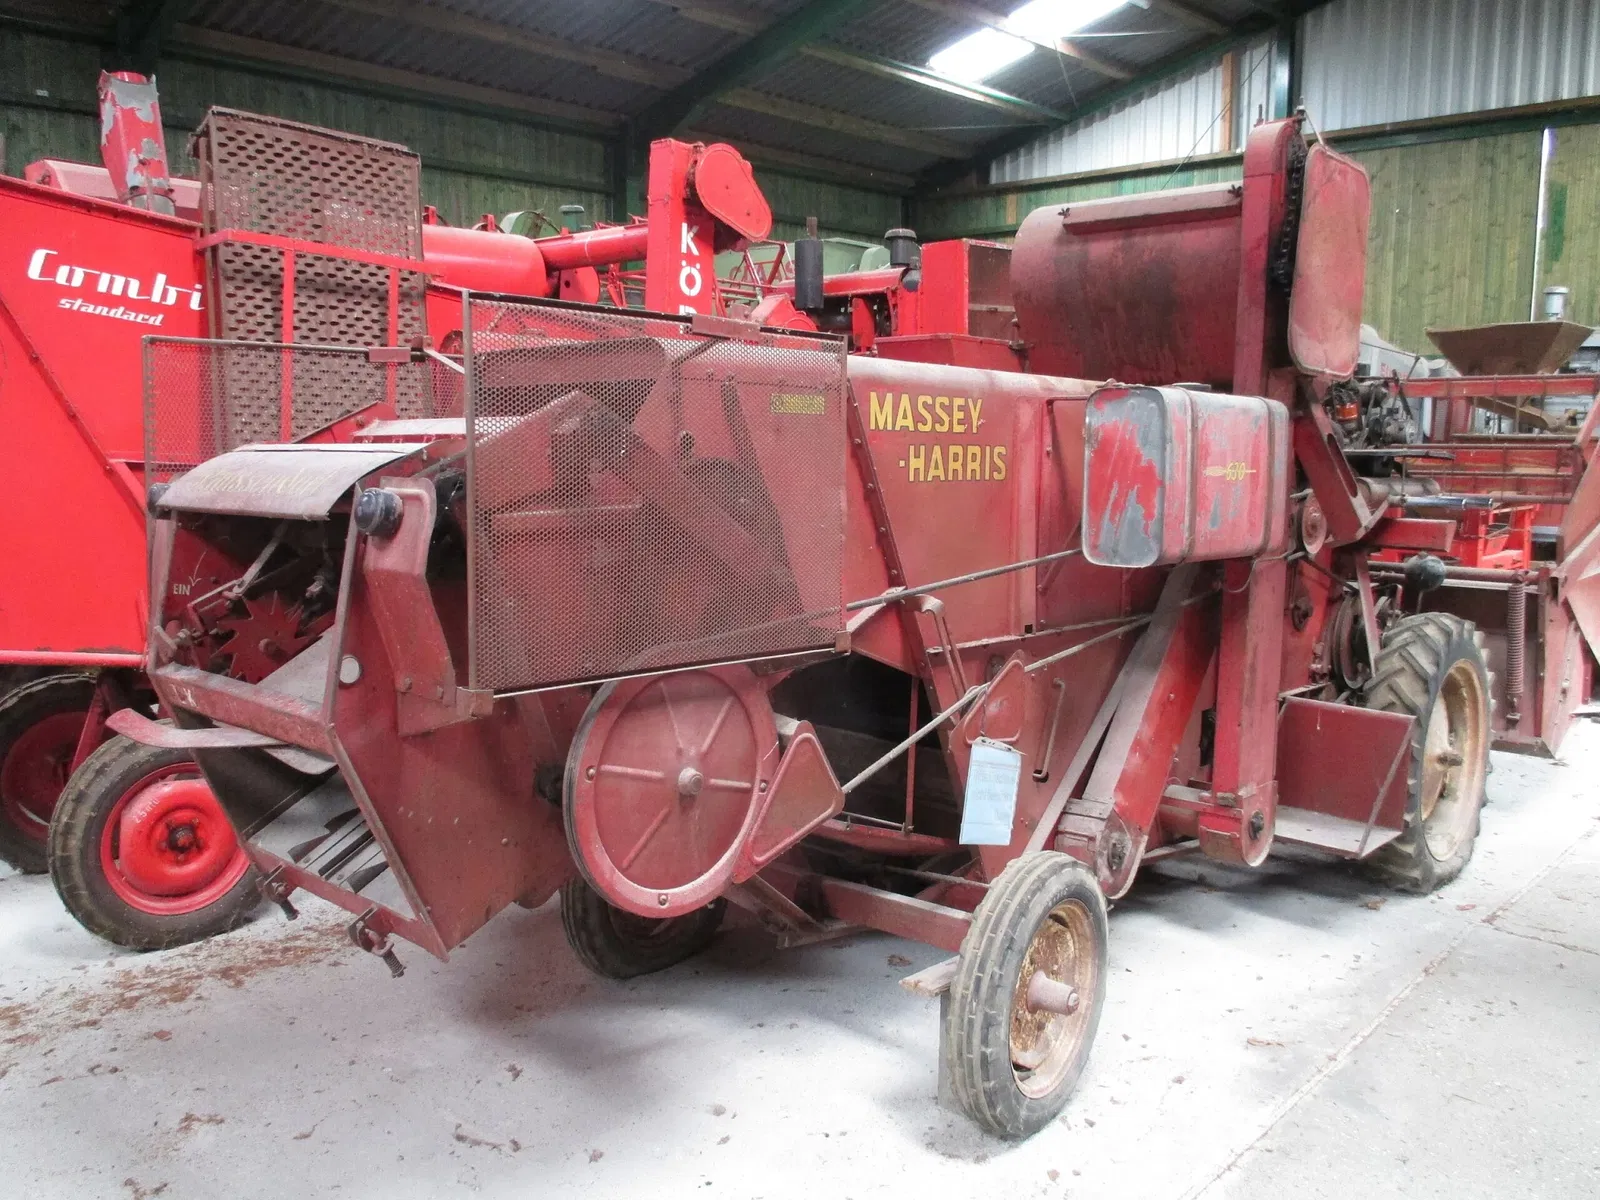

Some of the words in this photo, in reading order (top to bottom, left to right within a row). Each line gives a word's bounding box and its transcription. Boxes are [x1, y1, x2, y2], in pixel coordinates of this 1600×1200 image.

[27, 248, 205, 311] Combi
[57, 297, 165, 327] standard
[868, 390, 983, 434] MASSEY
[172, 583, 191, 596] EIN
